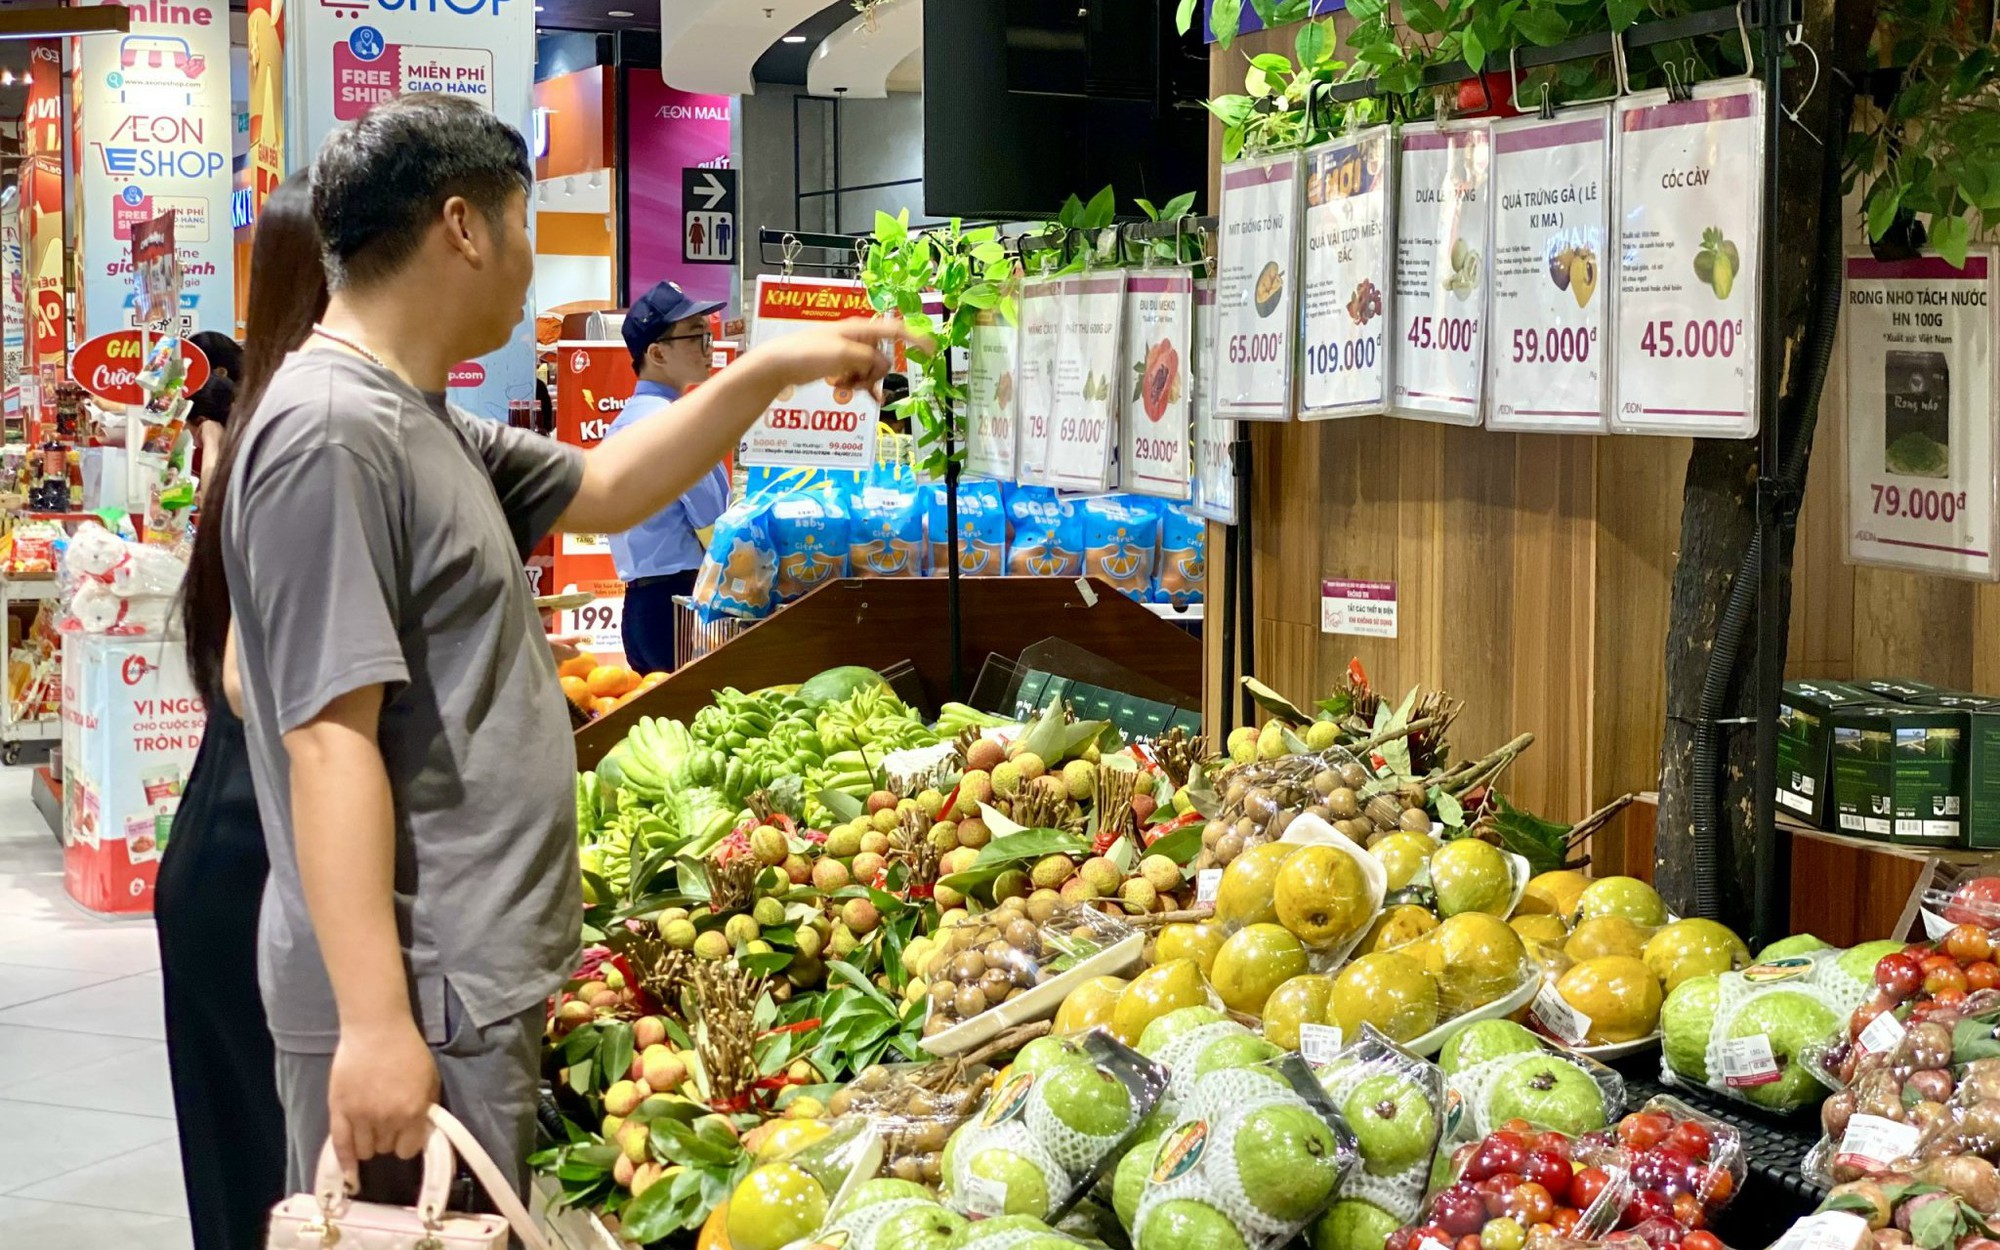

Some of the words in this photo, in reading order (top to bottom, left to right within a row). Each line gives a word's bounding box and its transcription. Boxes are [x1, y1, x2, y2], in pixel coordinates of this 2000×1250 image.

[103, 0, 213, 26] nline
[342, 69, 391, 86] FREE
[408, 61, 451, 79] MIỄN
[457, 66, 485, 81] PHÍ
[408, 81, 442, 92] GIAO
[447, 78, 487, 94] HÀNG
[342, 87, 393, 104] SHIP
[1662, 168, 1683, 189] CÓC
[1686, 166, 1710, 186] CÀY
[1416, 188, 1434, 203] DƯA
[1502, 190, 1522, 210] QUẢ
[1525, 188, 1558, 207] TRỨNG
[1561, 184, 1575, 203] GÀ
[1586, 182, 1596, 200] LÊ
[117, 209, 148, 221] FREE
[1530, 214, 1538, 228] KI
[1542, 213, 1557, 227] MA
[766, 287, 841, 309] KHUYẾN
[1850, 290, 1883, 305] RONG
[1886, 290, 1914, 305] NHO
[1917, 288, 1948, 305] TÁCH
[1951, 288, 1987, 306] NƯỚC
[1892, 312, 1911, 326] HN
[1915, 313, 1943, 327] 100G
[1935, 334, 1953, 344] Nam
[93, 364, 136, 390] Cuộc
[1870, 484, 1966, 522] 79.000đ
[134, 700, 154, 719] VỊ
[160, 698, 207, 715] NGO
[133, 722, 157, 731] CHO
[159, 720, 189, 731] CUỘC
